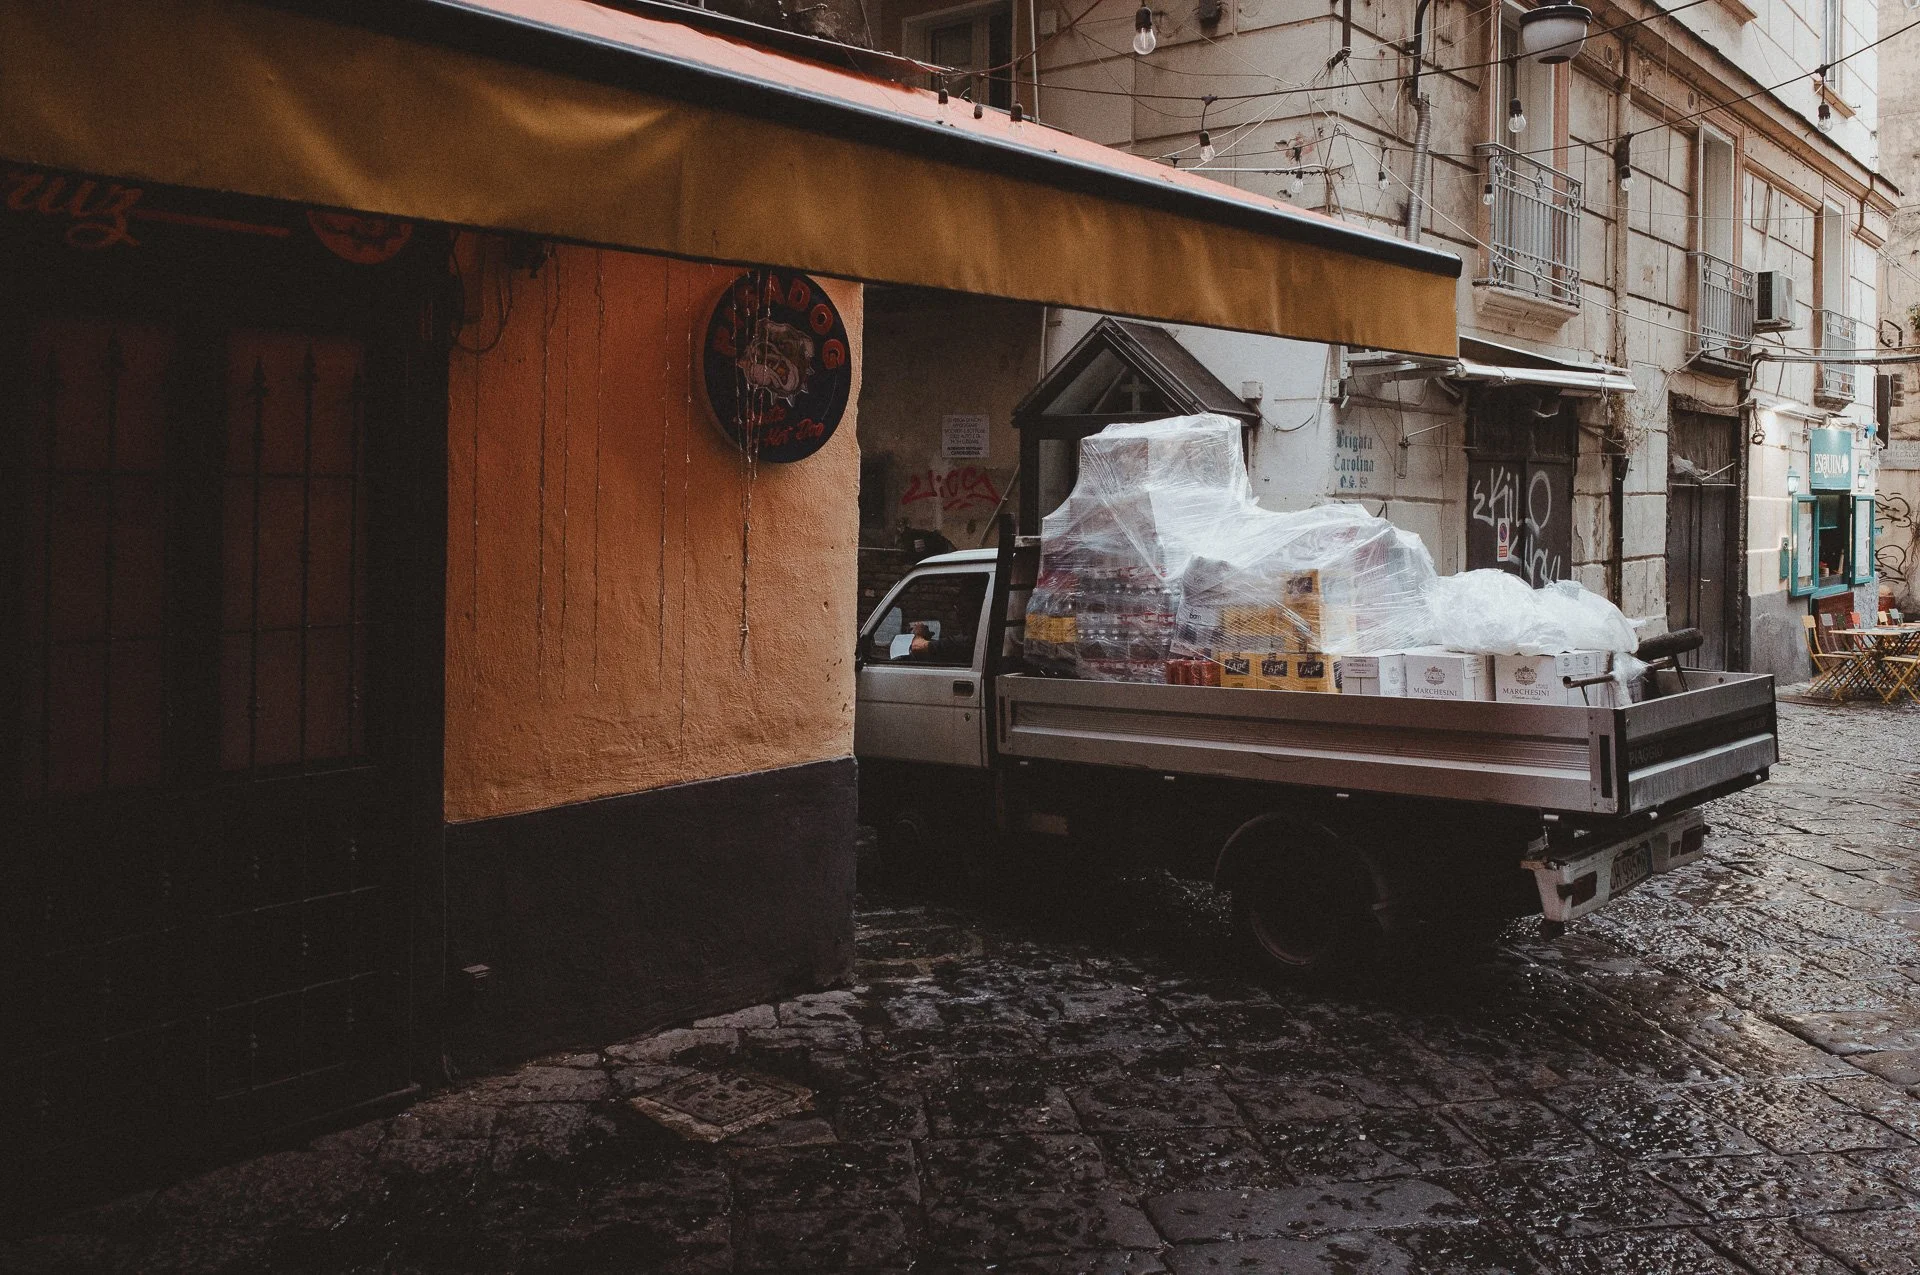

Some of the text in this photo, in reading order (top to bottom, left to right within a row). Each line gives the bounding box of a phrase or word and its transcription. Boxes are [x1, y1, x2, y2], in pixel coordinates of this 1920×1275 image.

[1333, 453, 1374, 472] Carolina
[1413, 687, 1458, 697] MARCHESINI
[1502, 688, 1550, 697] MARCHESINI
